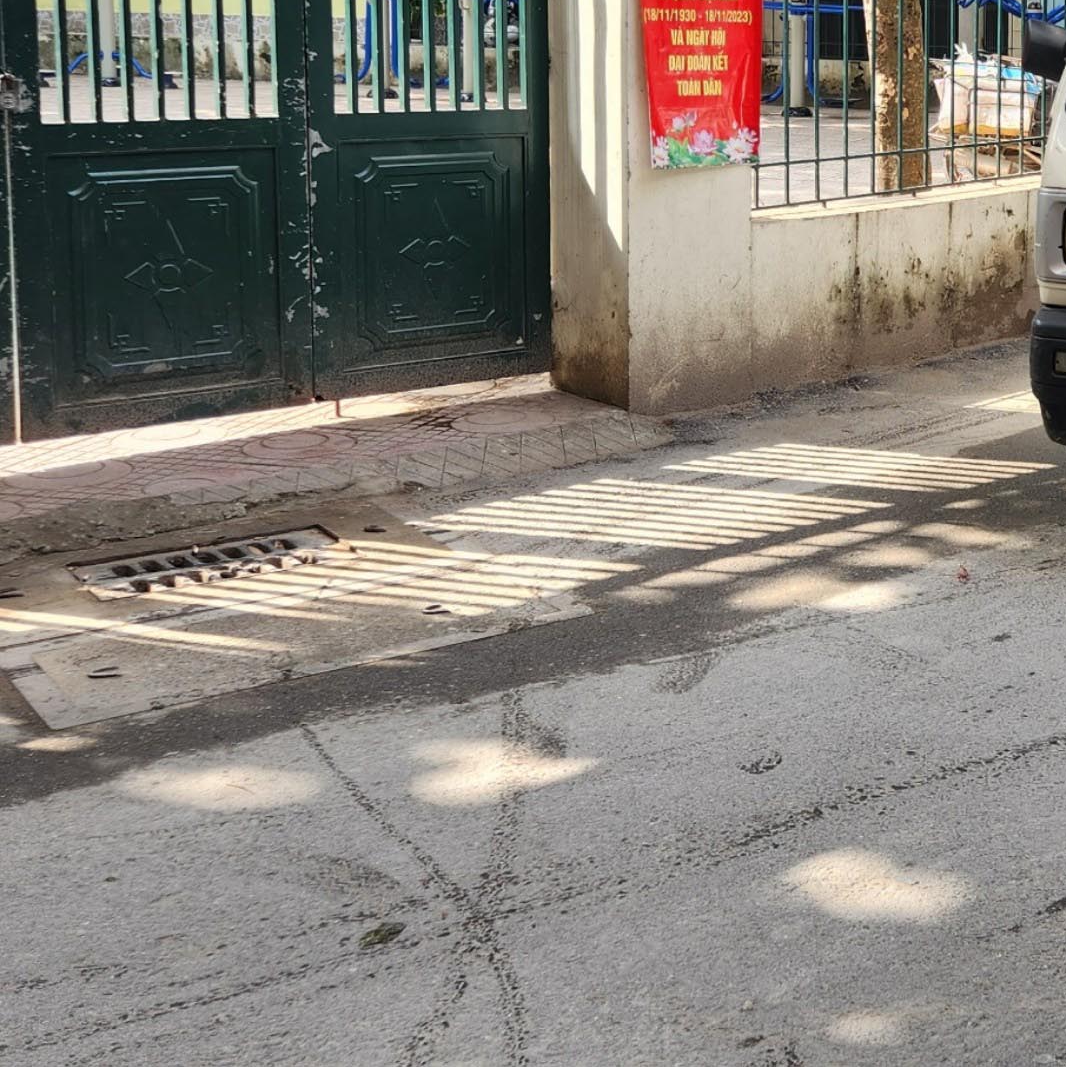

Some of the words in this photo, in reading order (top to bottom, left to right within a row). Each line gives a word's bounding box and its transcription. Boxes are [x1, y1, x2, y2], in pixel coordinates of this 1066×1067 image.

[643, 7, 696, 25] (18/11/1930
[705, 9, 753, 26] 18/11/2023)
[671, 26, 684, 46] VÀ
[686, 26, 710, 46] NGÀY
[711, 26, 726, 49] HỘI
[668, 54, 685, 74] ĐẠI
[687, 53, 711, 71] ĐOÀN
[712, 50, 728, 71] KẾT
[677, 77, 701, 96] TOÀN
[703, 76, 722, 96] DÂN
